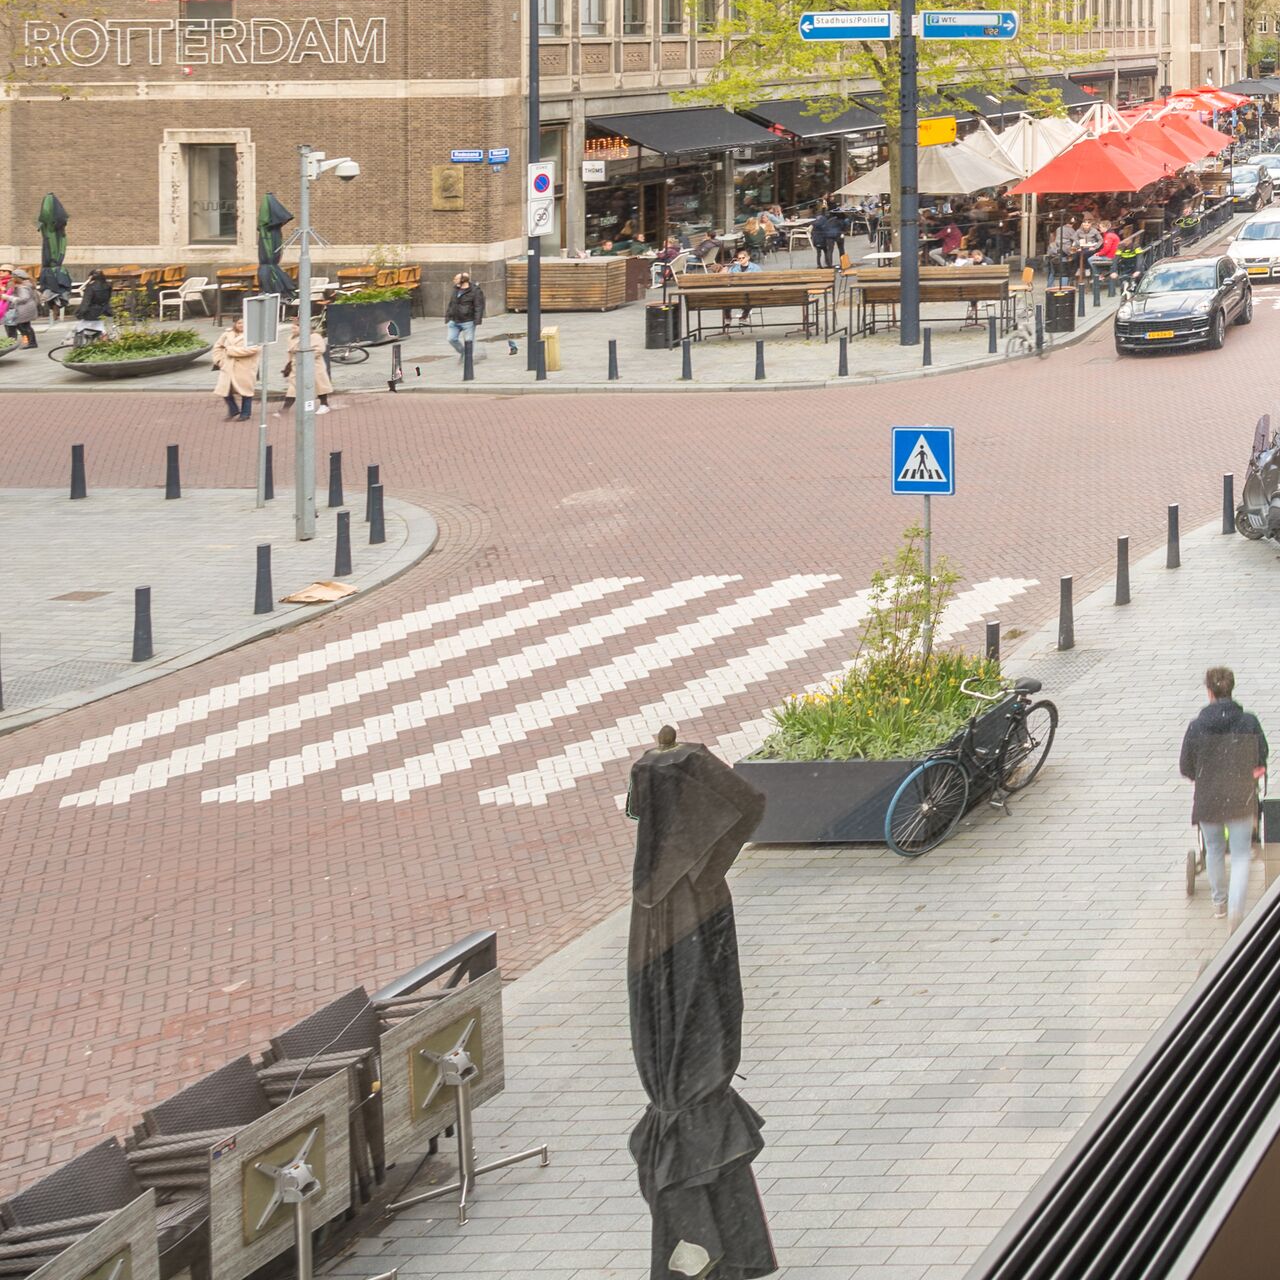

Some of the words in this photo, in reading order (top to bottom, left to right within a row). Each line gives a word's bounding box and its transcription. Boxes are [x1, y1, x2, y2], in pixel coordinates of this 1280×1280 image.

[815, 16, 886, 25] Stadhuis/Politie
[25, 18, 387, 67] ROTTERDAM
[537, 213, 547, 222] 30
